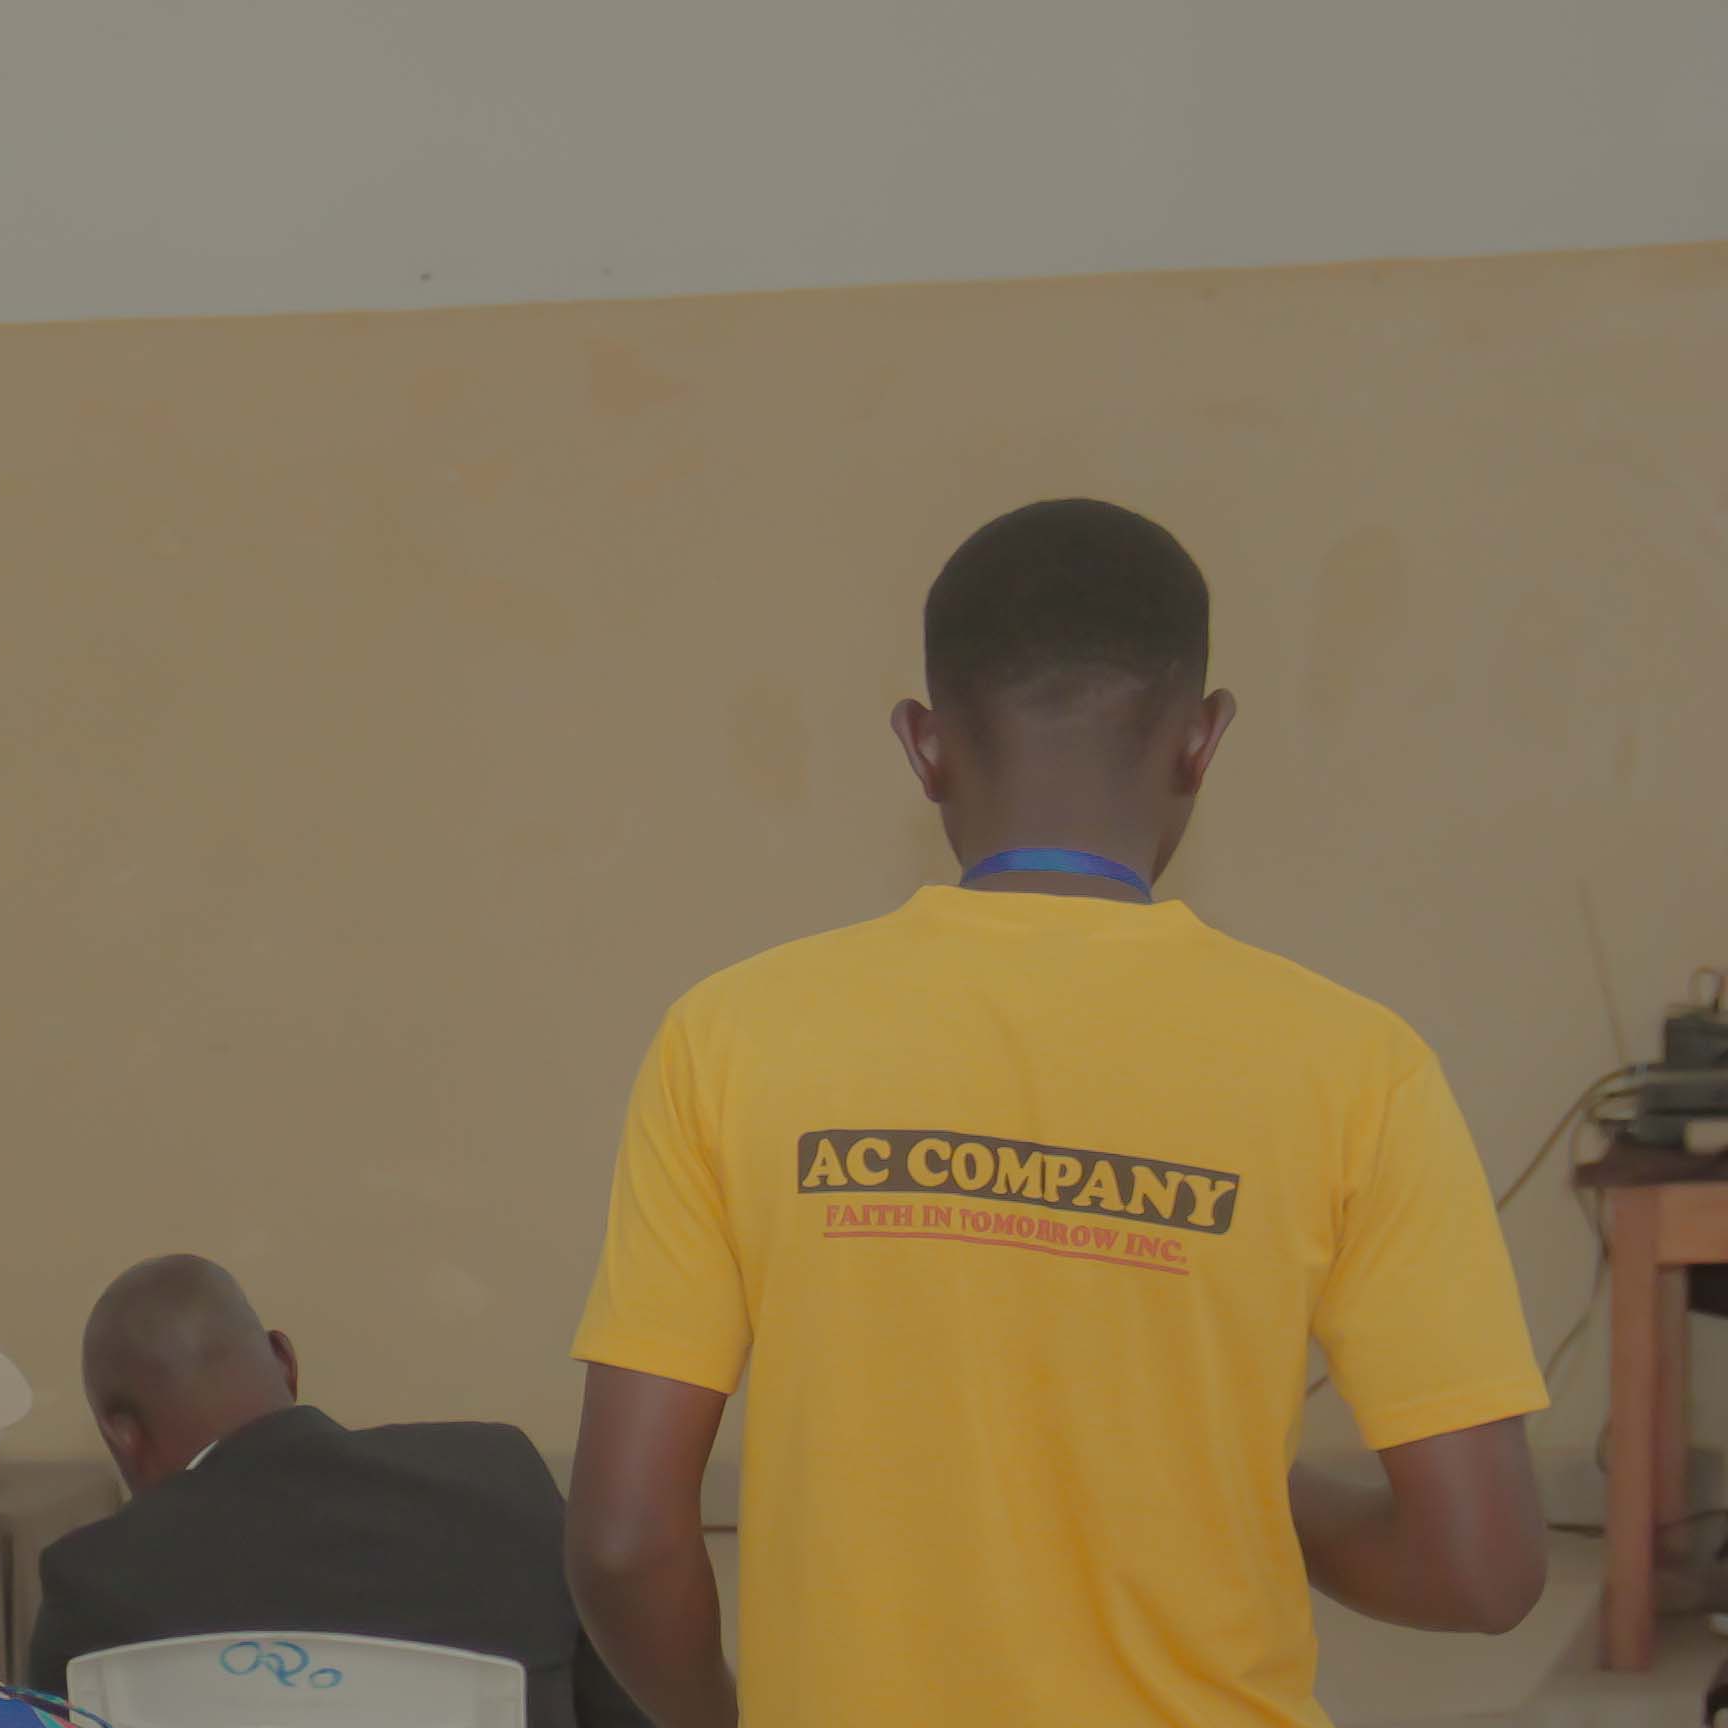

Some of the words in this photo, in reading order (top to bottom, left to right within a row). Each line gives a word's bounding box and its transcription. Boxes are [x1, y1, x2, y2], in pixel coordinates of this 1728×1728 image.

[802, 1137, 891, 1188] AC
[906, 1137, 1237, 1227] COMPANY
[825, 1204, 913, 1229] FAITH
[921, 1205, 953, 1229] IN
[960, 1207, 1117, 1252] TOMORROW
[1124, 1232, 1188, 1265] INC.
